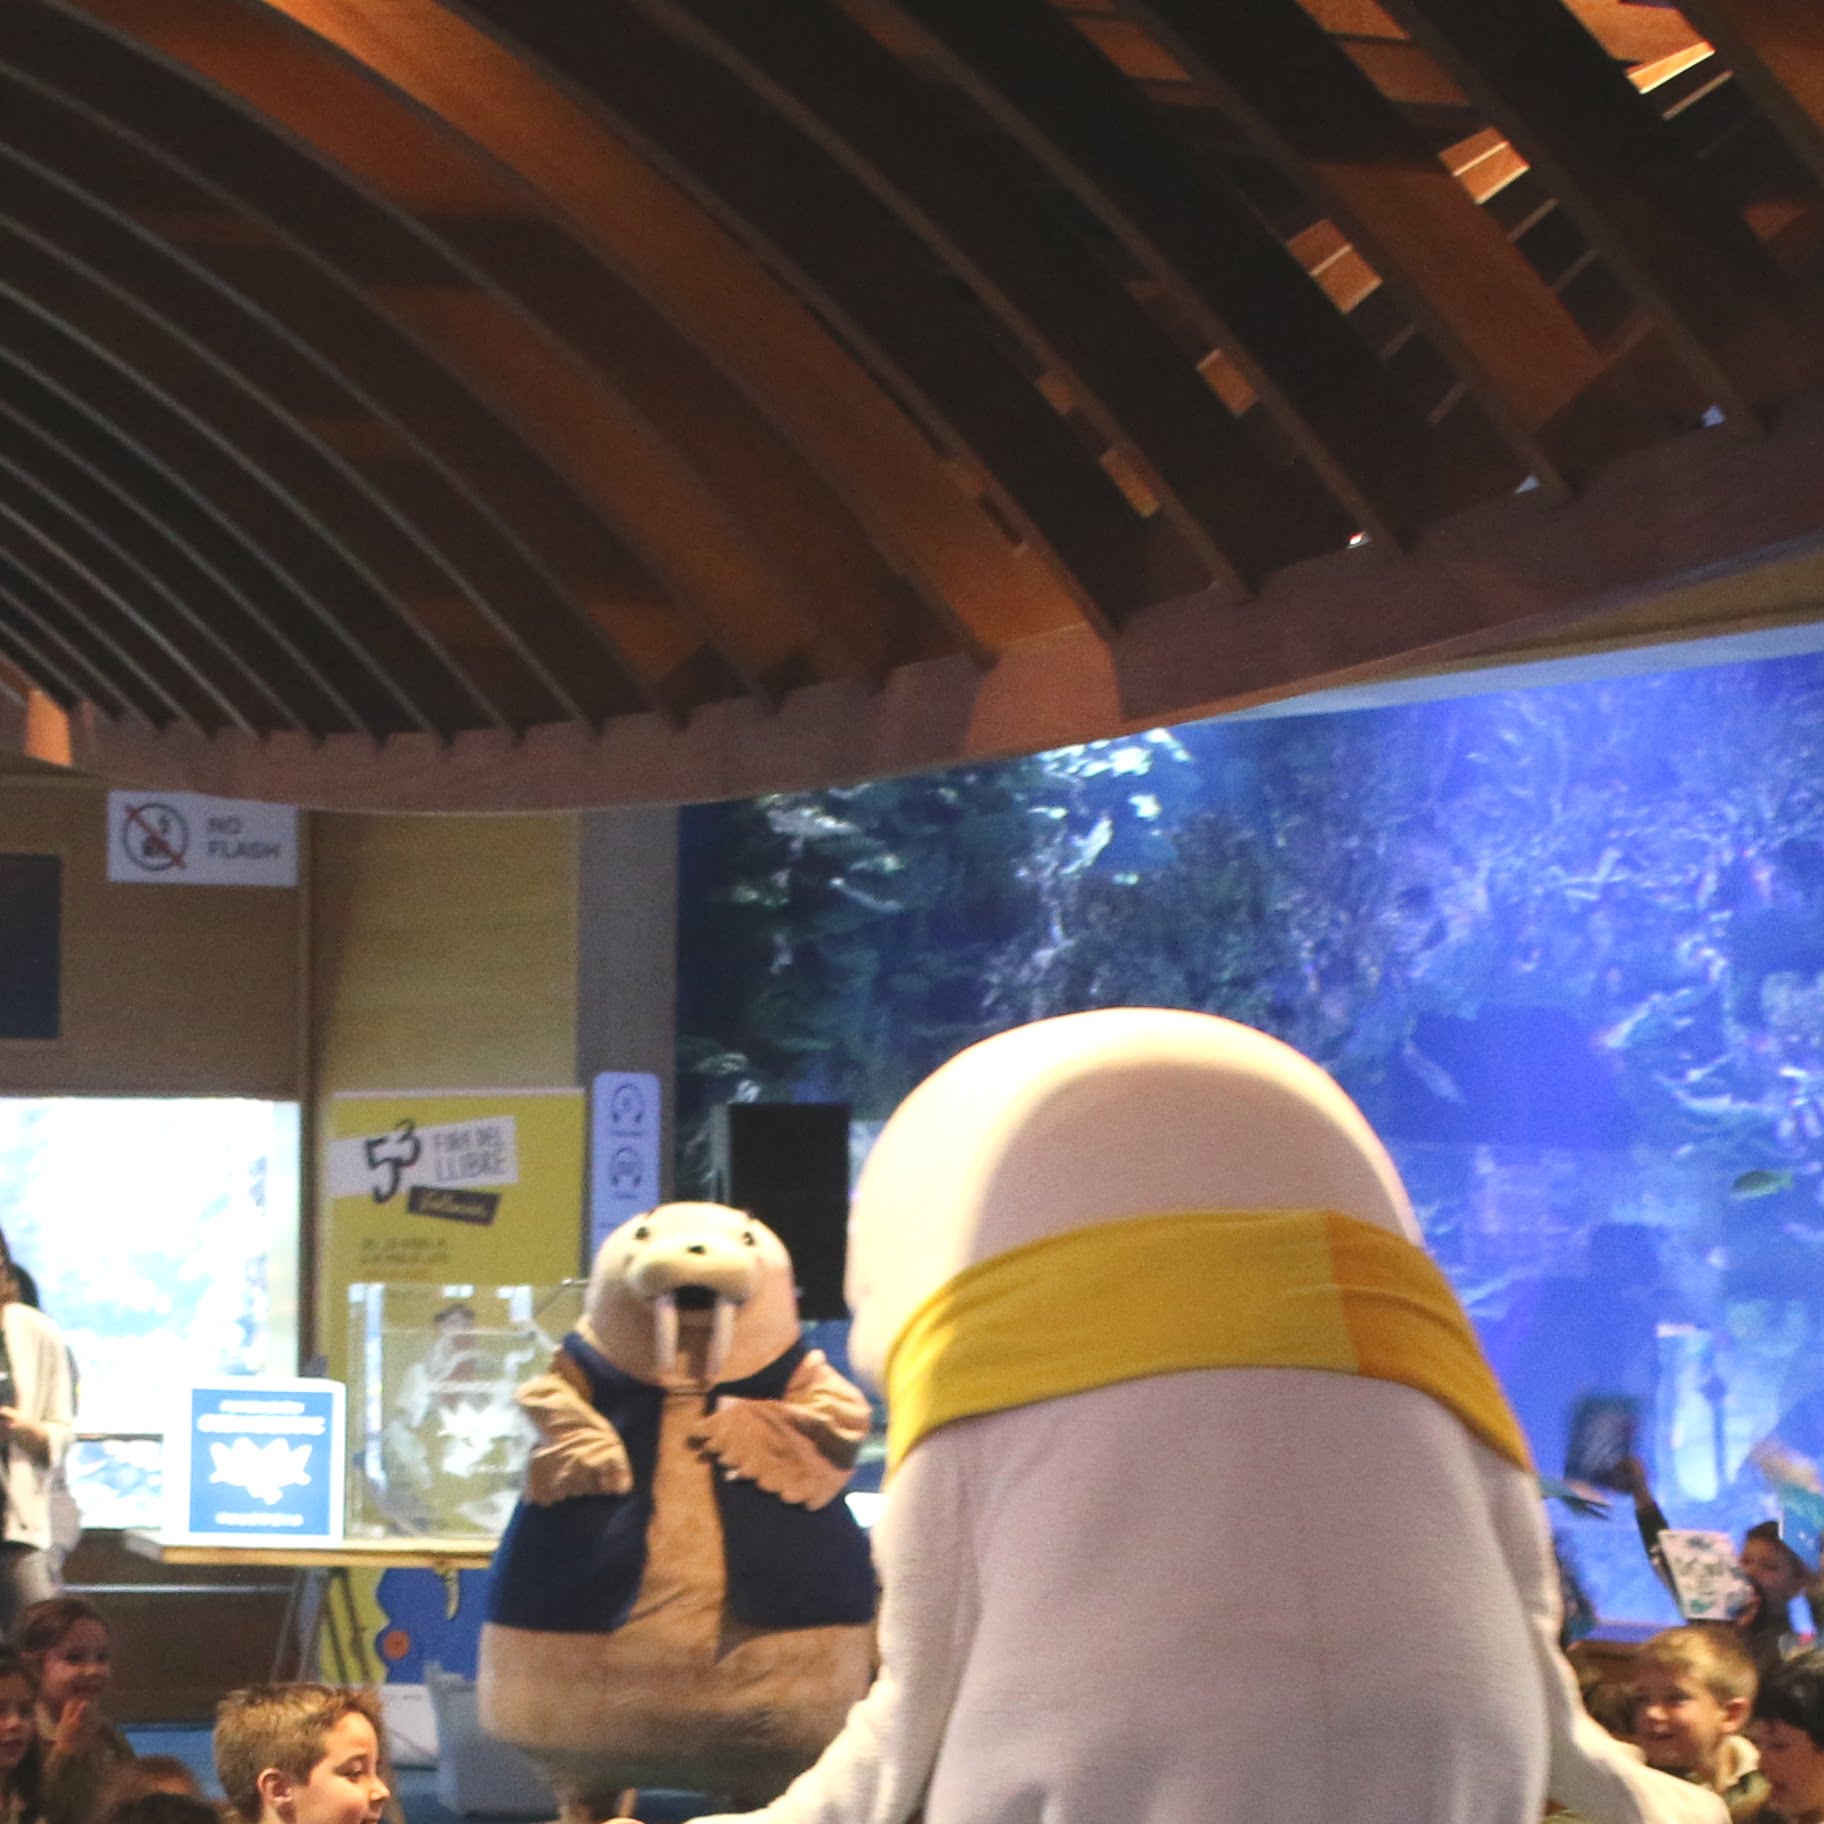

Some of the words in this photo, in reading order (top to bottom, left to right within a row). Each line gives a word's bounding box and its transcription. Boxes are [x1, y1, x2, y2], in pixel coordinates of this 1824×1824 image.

[207, 816, 244, 835] NO
[207, 839, 282, 860] FLASH
[363, 1117, 423, 1204] 53
